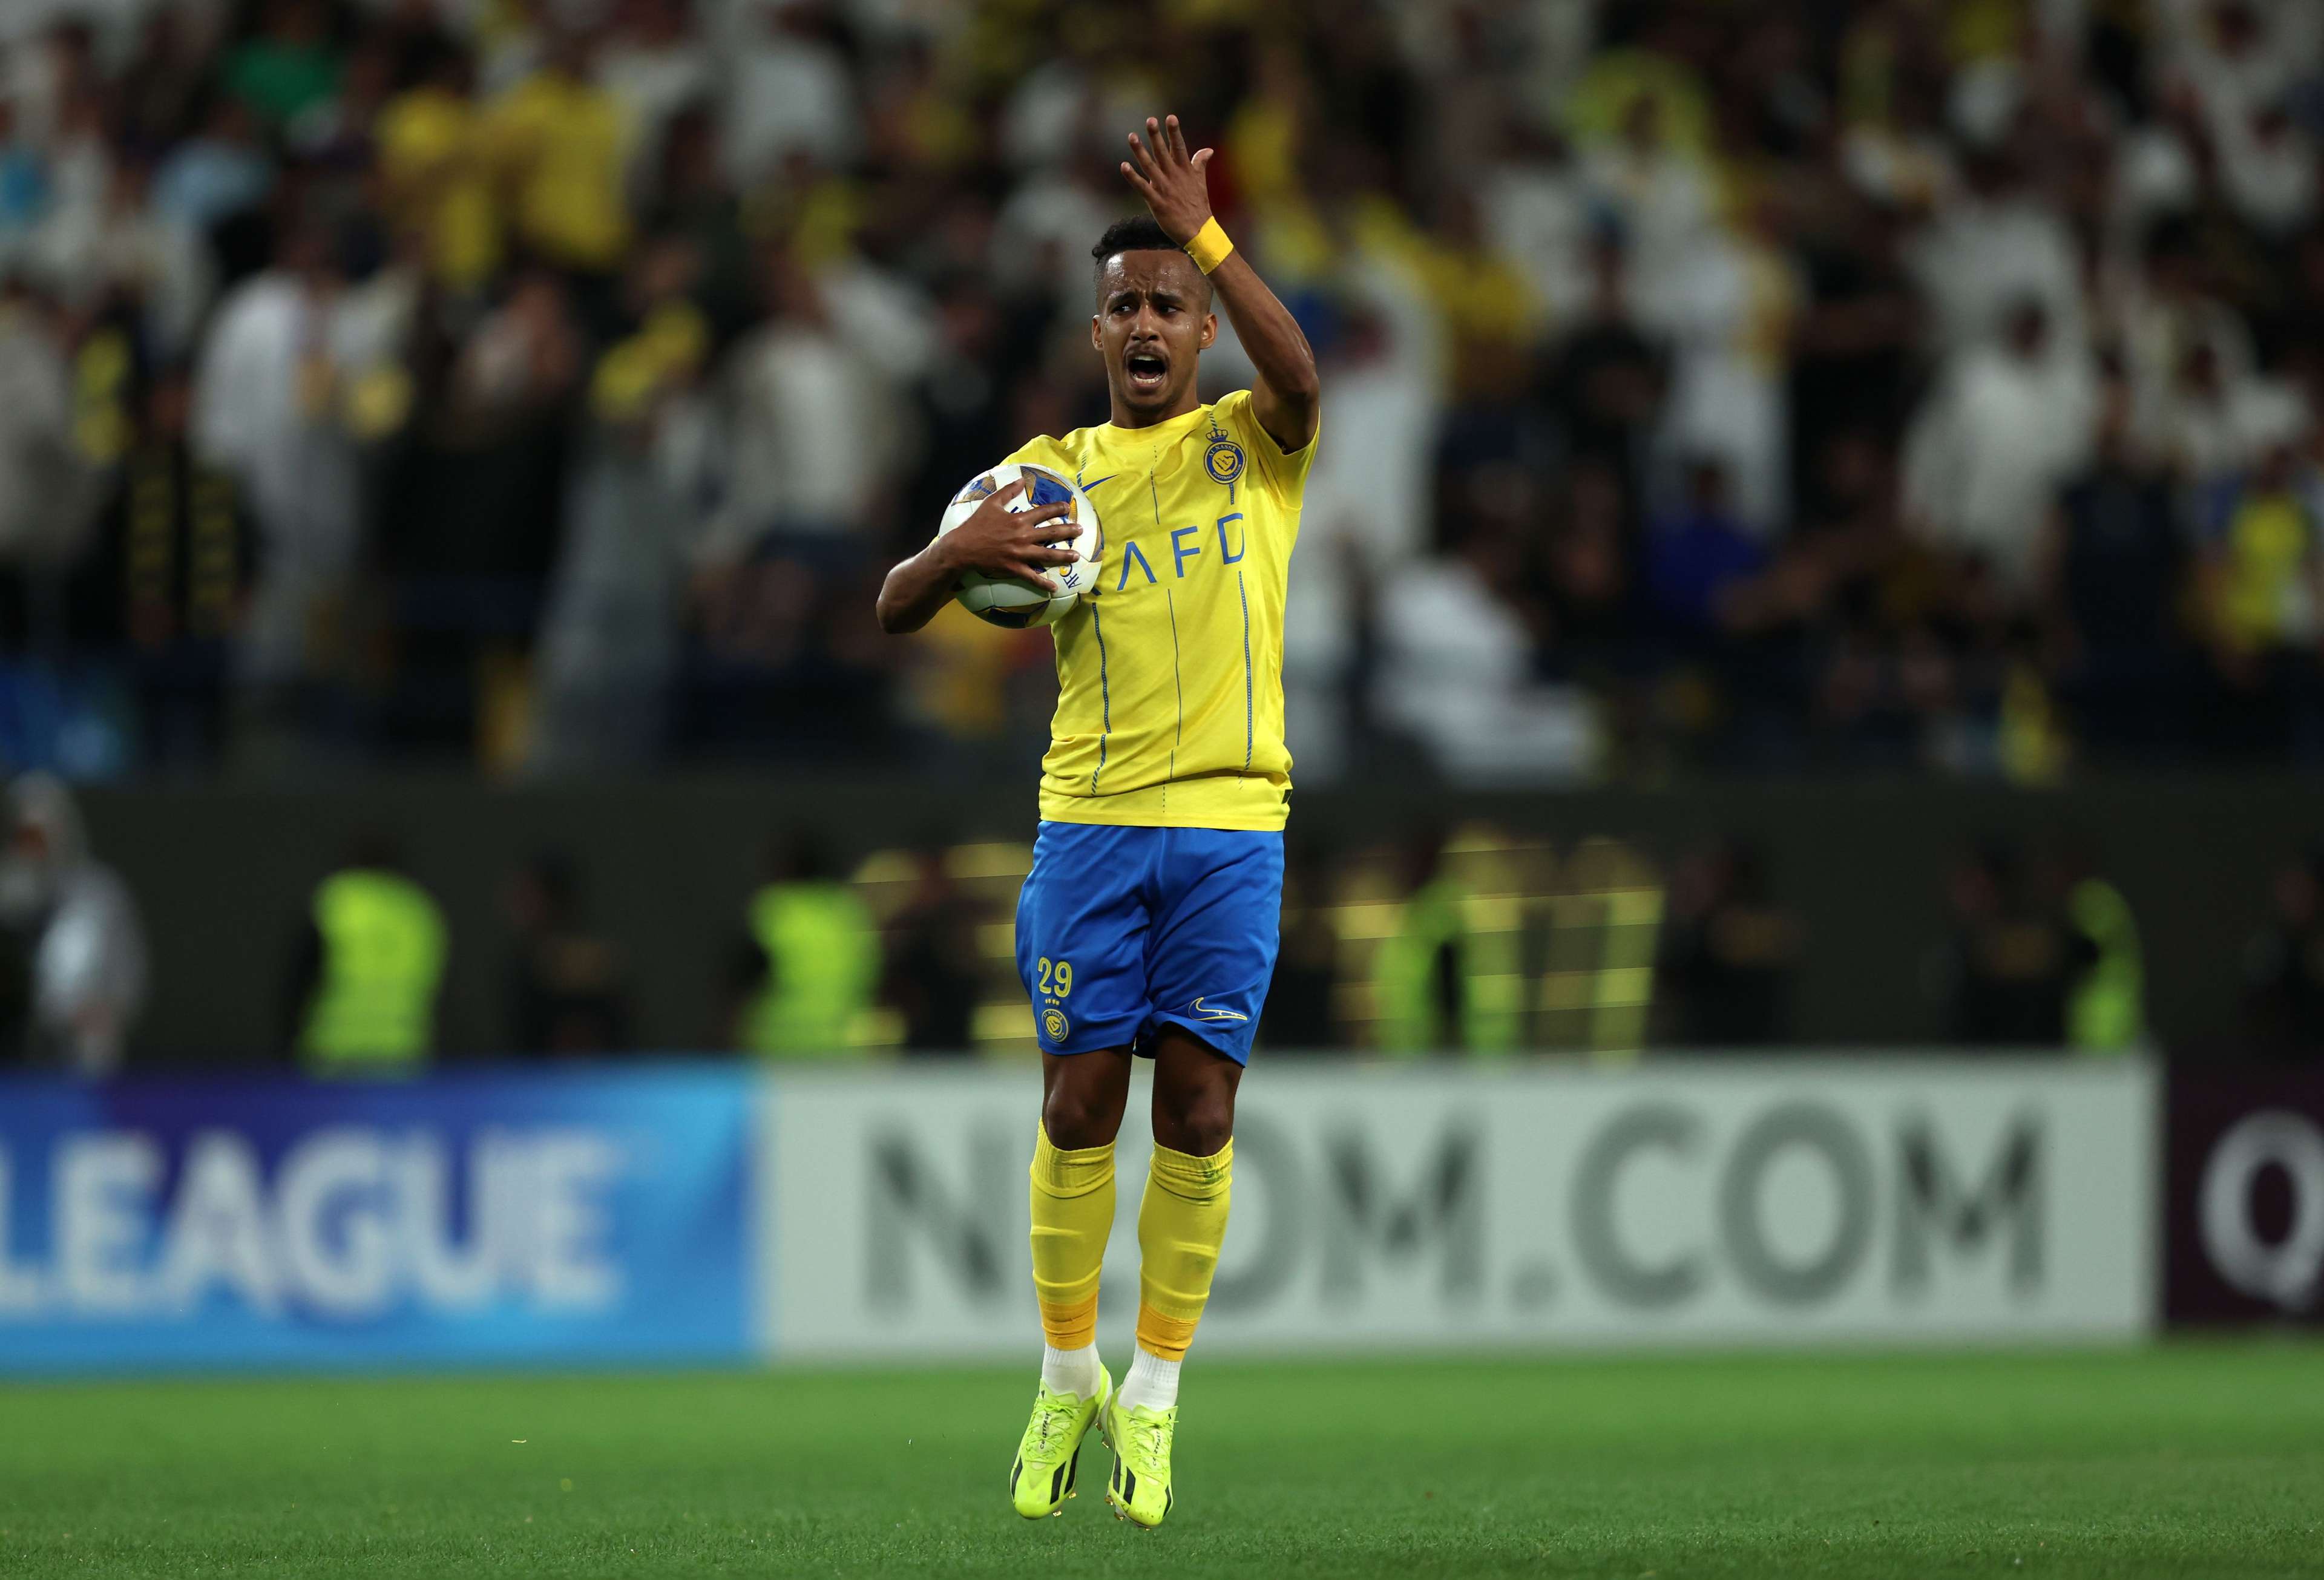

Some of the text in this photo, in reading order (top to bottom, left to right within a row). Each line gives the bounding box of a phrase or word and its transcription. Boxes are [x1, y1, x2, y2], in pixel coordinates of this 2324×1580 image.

[1091, 513, 1245, 595] AFD
[1038, 957, 1072, 998] 29
[862, 1104, 2046, 1308] NOM.COM
